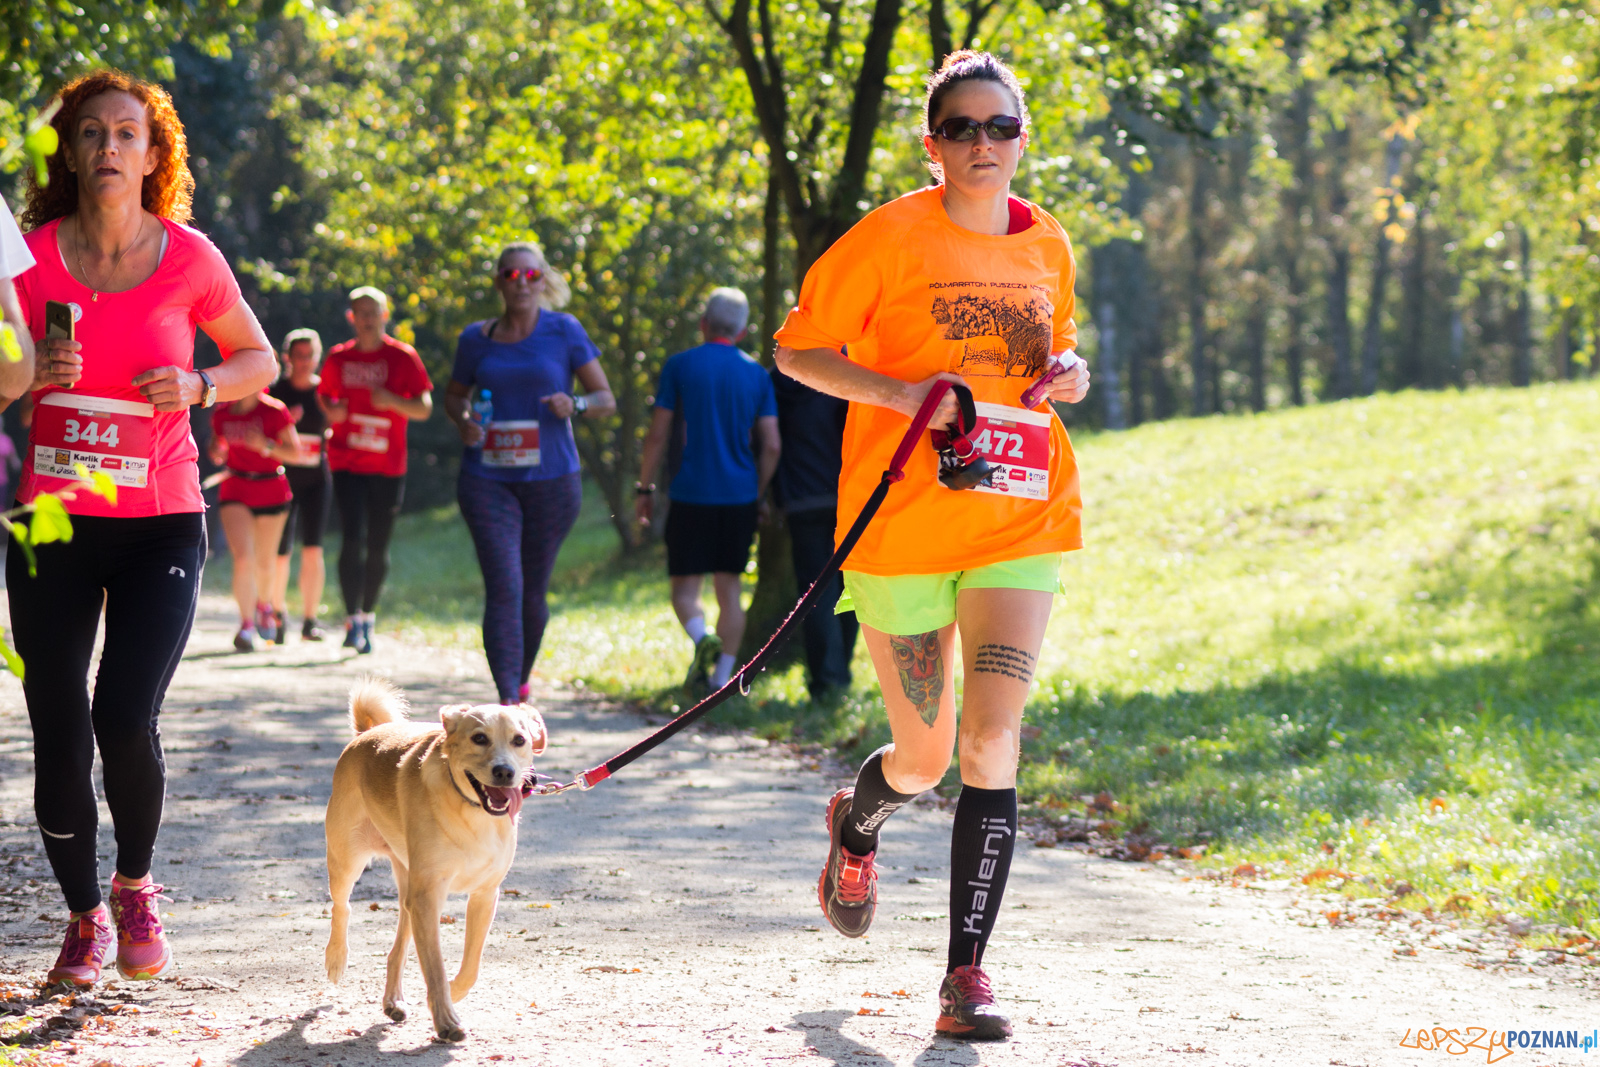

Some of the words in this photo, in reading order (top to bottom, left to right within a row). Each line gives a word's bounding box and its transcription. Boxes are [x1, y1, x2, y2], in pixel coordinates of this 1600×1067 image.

[63, 419, 119, 447] 344
[973, 428, 1024, 459] 472
[73, 453, 99, 463] Karlik
